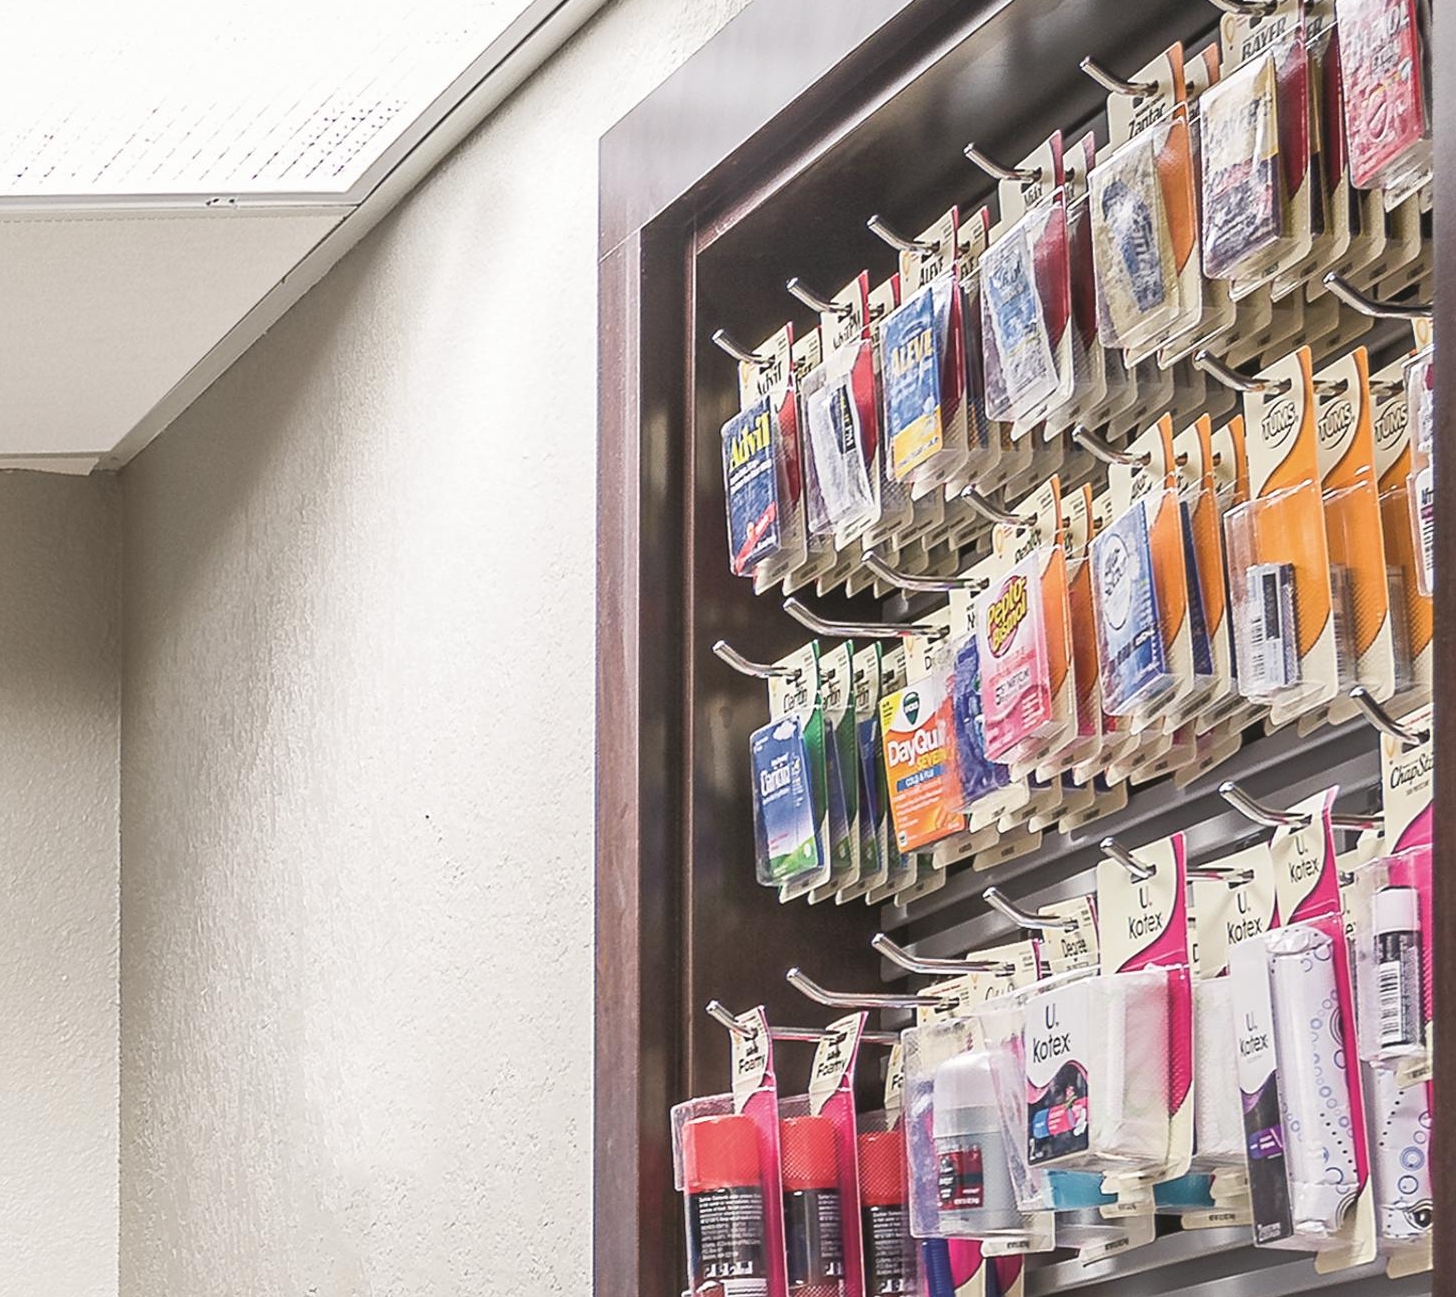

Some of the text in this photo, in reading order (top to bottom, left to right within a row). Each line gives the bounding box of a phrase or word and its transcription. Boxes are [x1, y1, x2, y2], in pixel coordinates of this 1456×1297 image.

[1242, 18, 1287, 62] BAYER
[891, 328, 933, 376] ALEVE
[730, 411, 771, 471] Advil
[1261, 402, 1296, 440] TUMS
[1318, 404, 1352, 441] TUMS
[1375, 407, 1408, 443] TUMS
